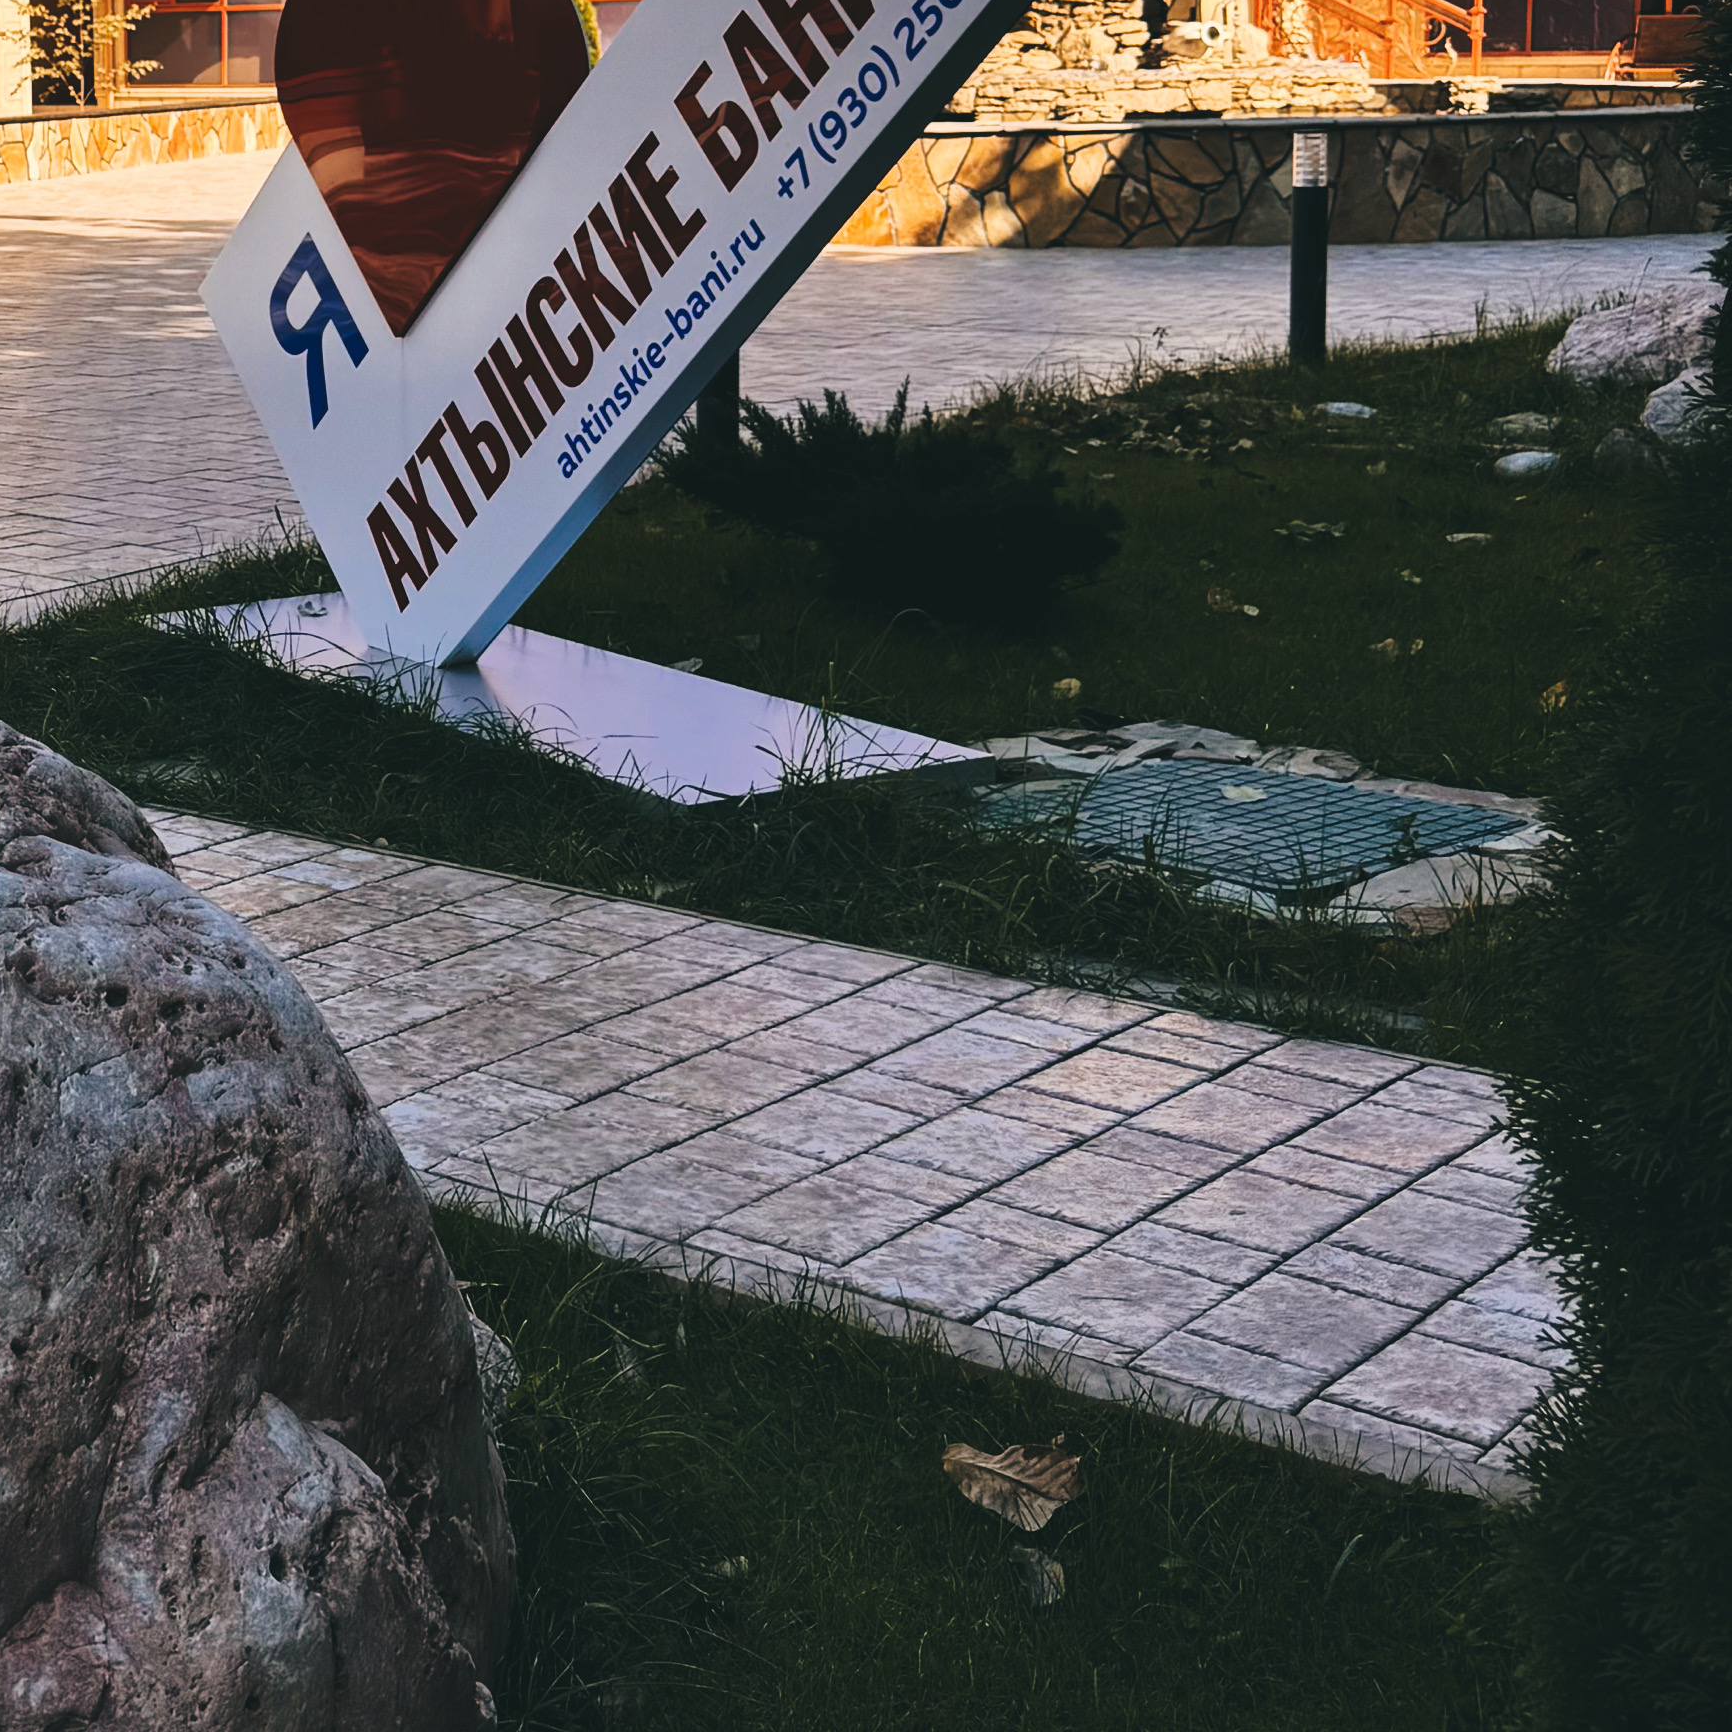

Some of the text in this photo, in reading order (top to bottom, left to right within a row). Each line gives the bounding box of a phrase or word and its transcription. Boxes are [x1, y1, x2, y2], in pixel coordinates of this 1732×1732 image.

[269, 233, 370, 431] Я
[366, 130, 708, 614] АХТЫНСКИЕ
[556, 217, 767, 480] ahtinskie-bani.ru
[776, 146, 811, 200] +7
[807, 44, 902, 165] (930)
